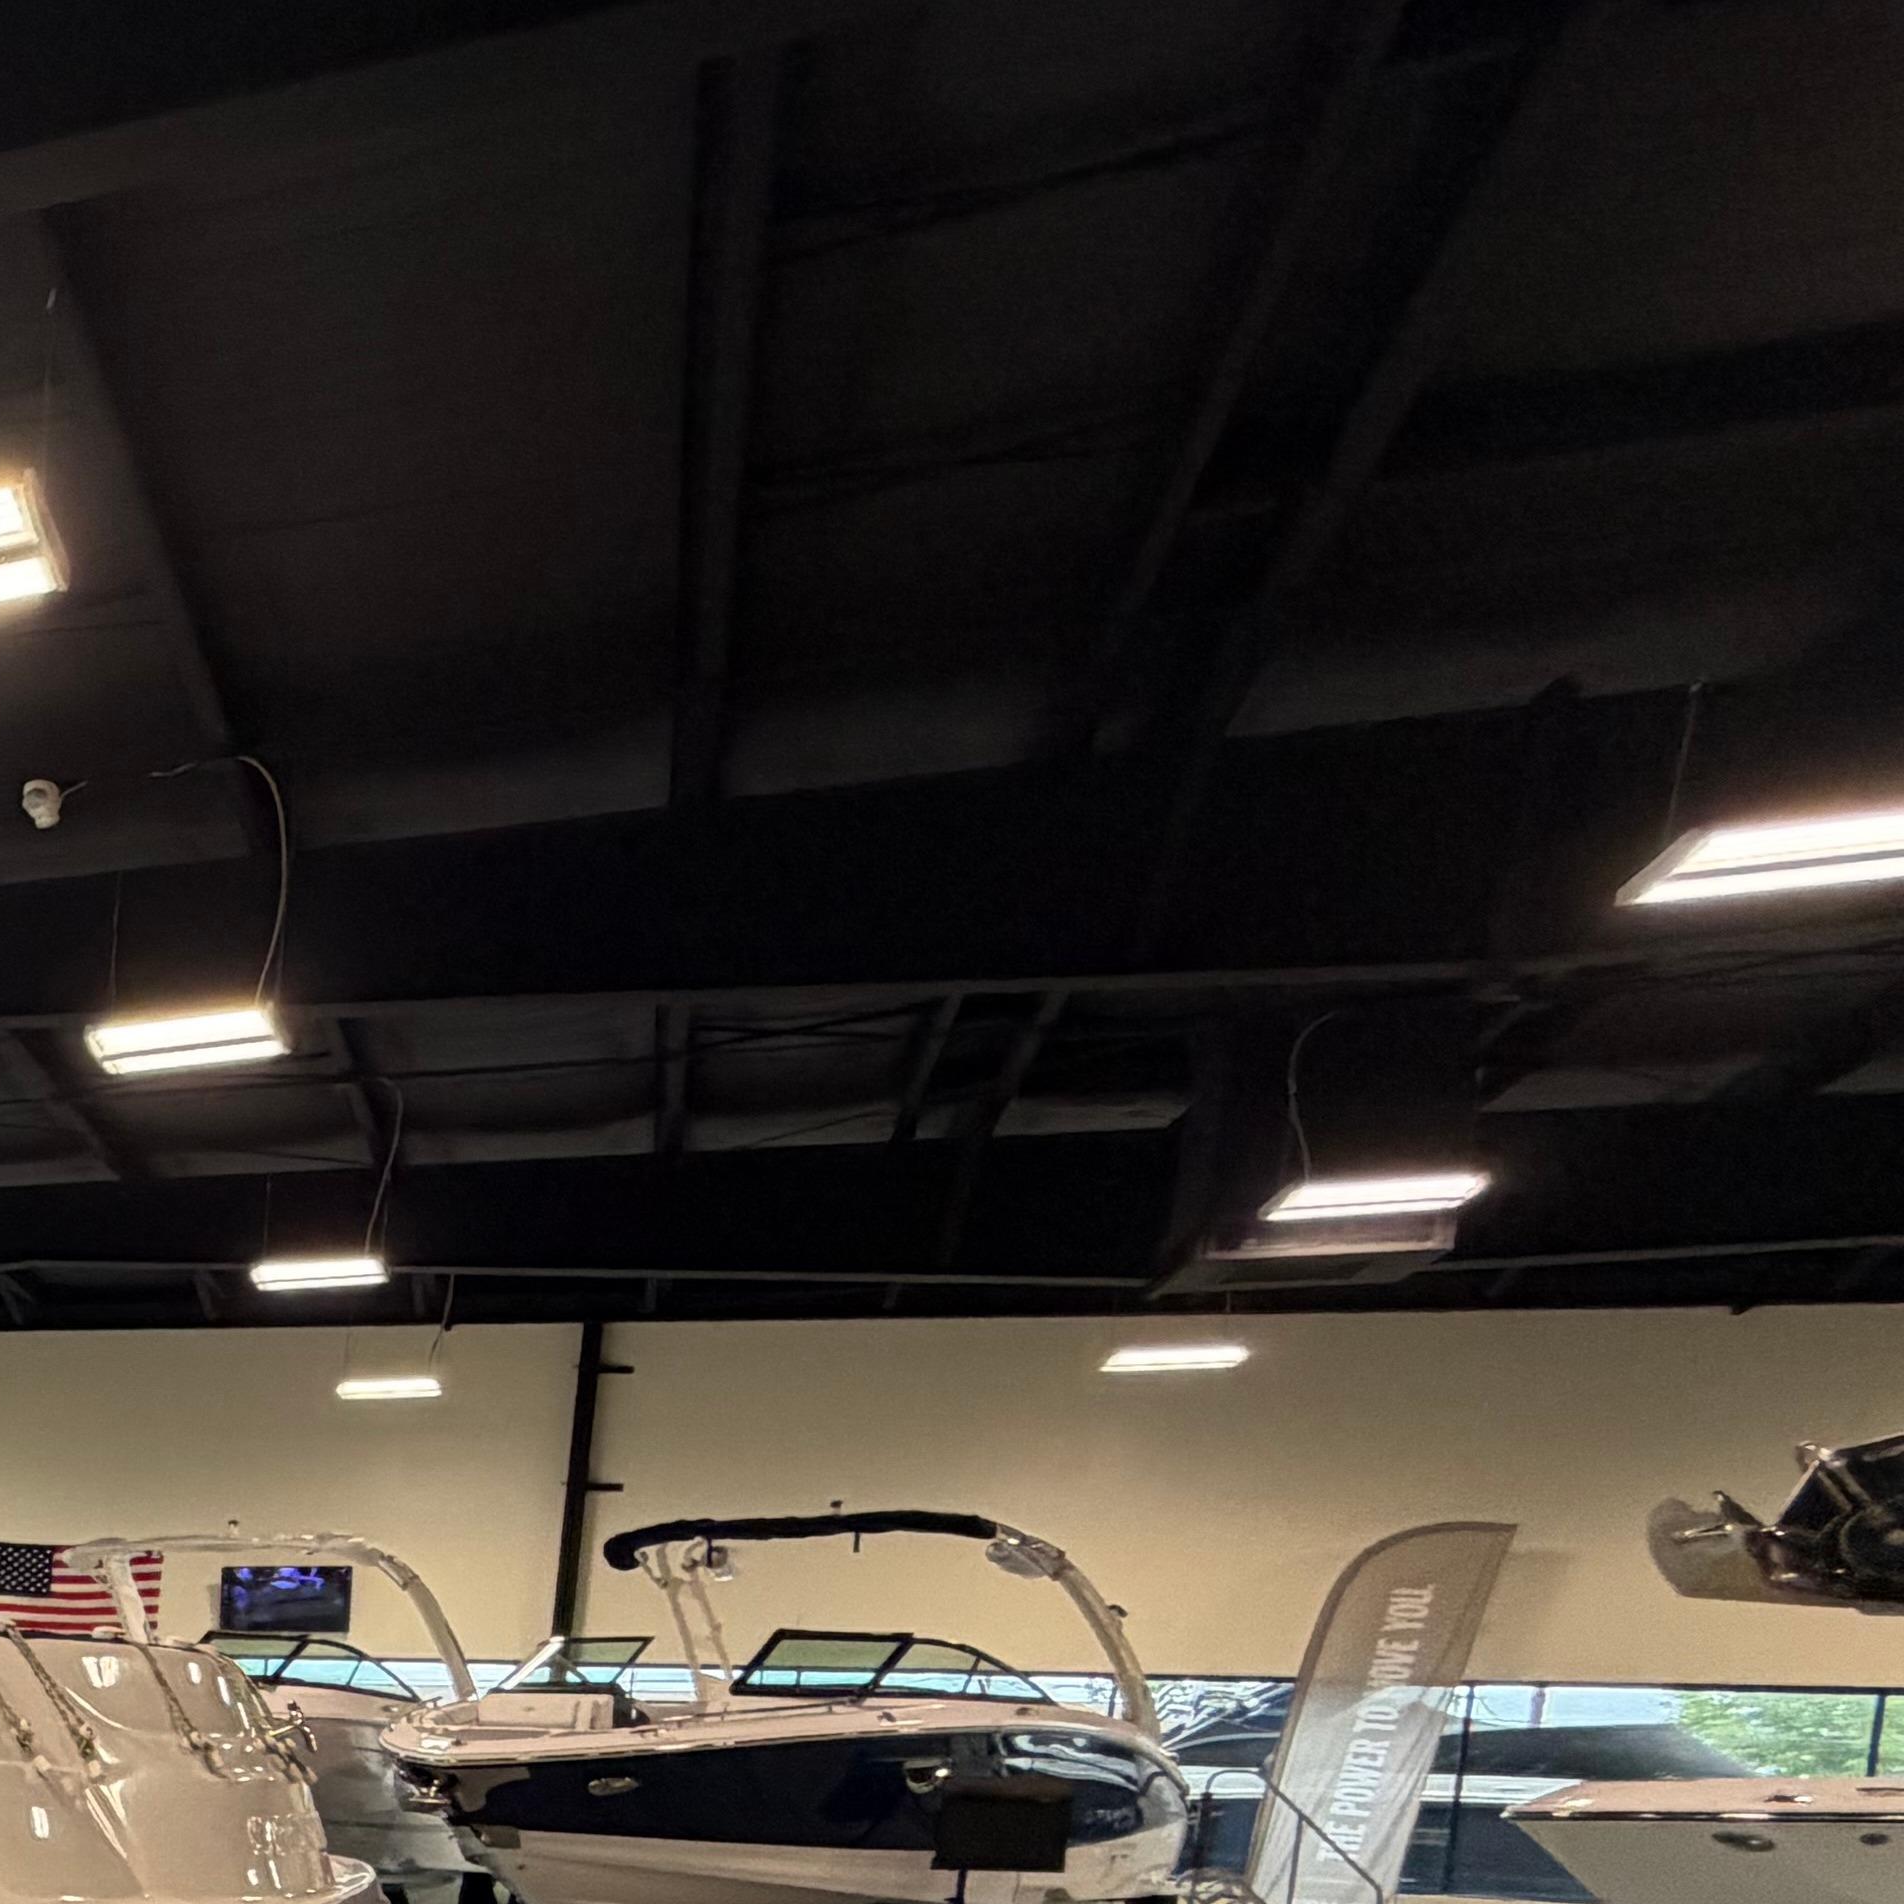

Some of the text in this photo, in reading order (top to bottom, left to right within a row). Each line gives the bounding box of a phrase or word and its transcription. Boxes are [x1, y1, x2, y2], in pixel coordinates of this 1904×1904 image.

[1352, 1705, 1399, 1733] TO
[1330, 1738, 1390, 1818] POWER
[1316, 1820, 1366, 1862] THE
